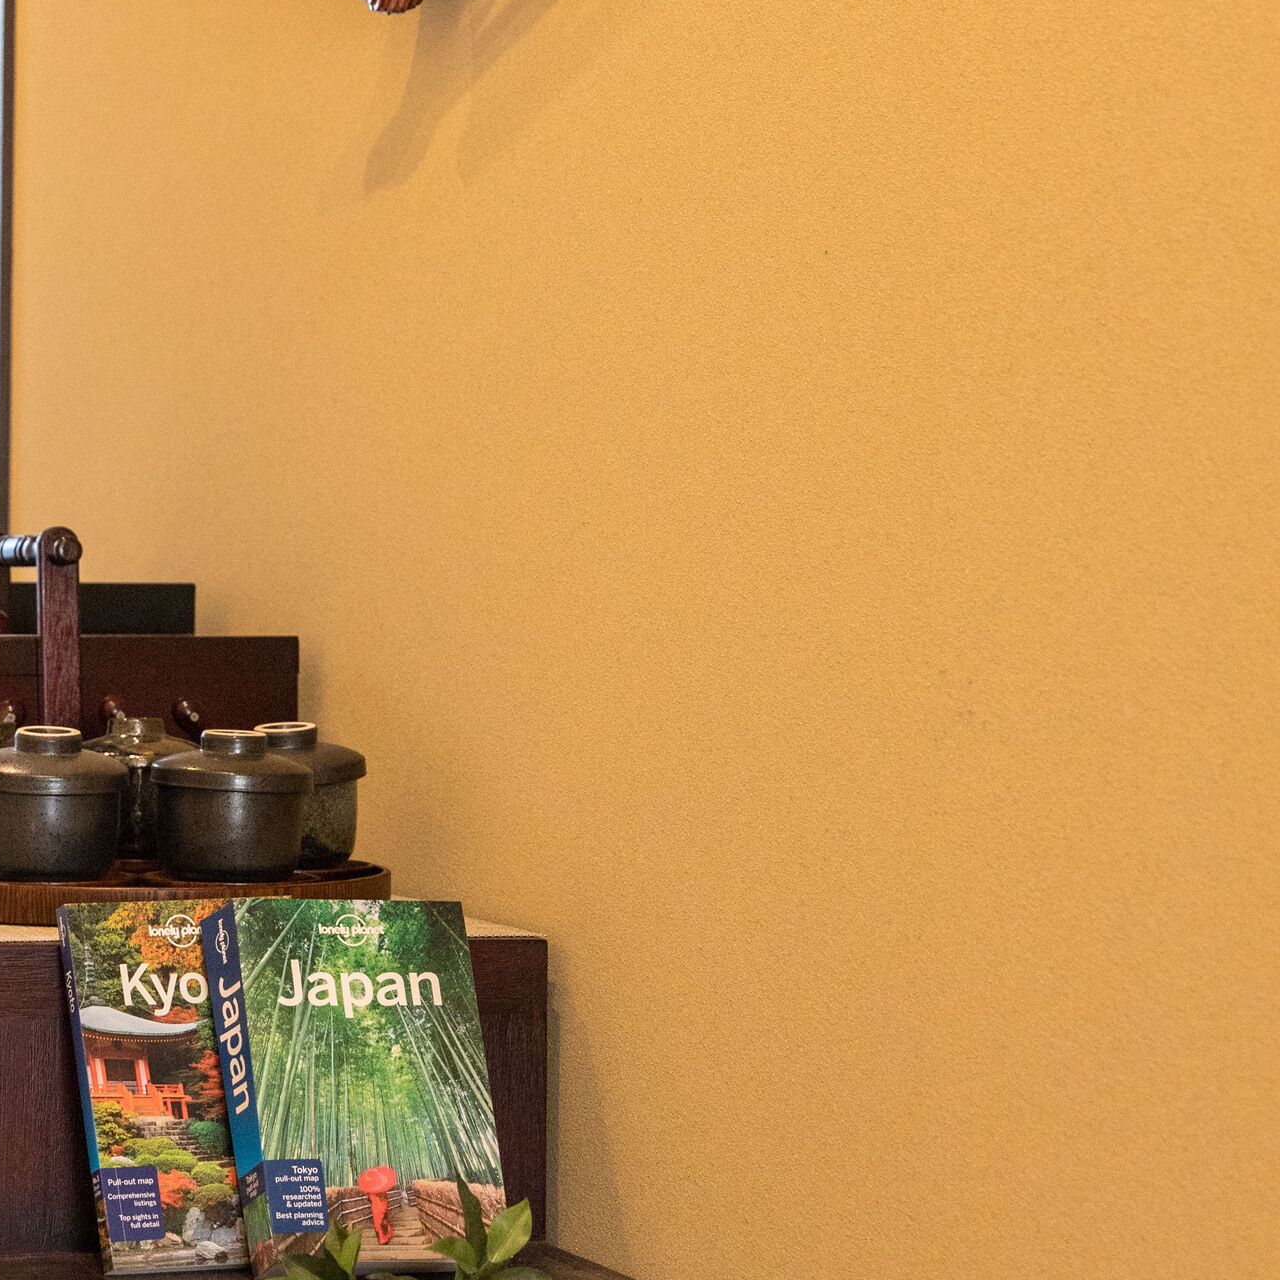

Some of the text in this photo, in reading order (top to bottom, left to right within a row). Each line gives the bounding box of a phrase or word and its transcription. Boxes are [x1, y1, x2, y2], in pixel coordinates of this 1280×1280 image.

[148, 924, 202, 939] lonely plan
[318, 923, 385, 937] lonely planet
[65, 970, 75, 1013] Kyoto
[119, 963, 209, 1017] Kyo
[277, 959, 443, 1019] Japan
[218, 977, 250, 1115] Japan
[291, 1165, 318, 1175] Tokyo
[107, 1178, 136, 1186] Pull-out
[275, 1175, 320, 1183] pull-out map
[299, 1185, 321, 1193] 100%
[107, 1192, 156, 1200] Comprehensive
[286, 1200, 322, 1208] & updated
[119, 1212, 159, 1222] Top sights in
[275, 1211, 324, 1220] Best planning
[130, 1221, 141, 1229] full
[301, 1218, 325, 1226] advice
